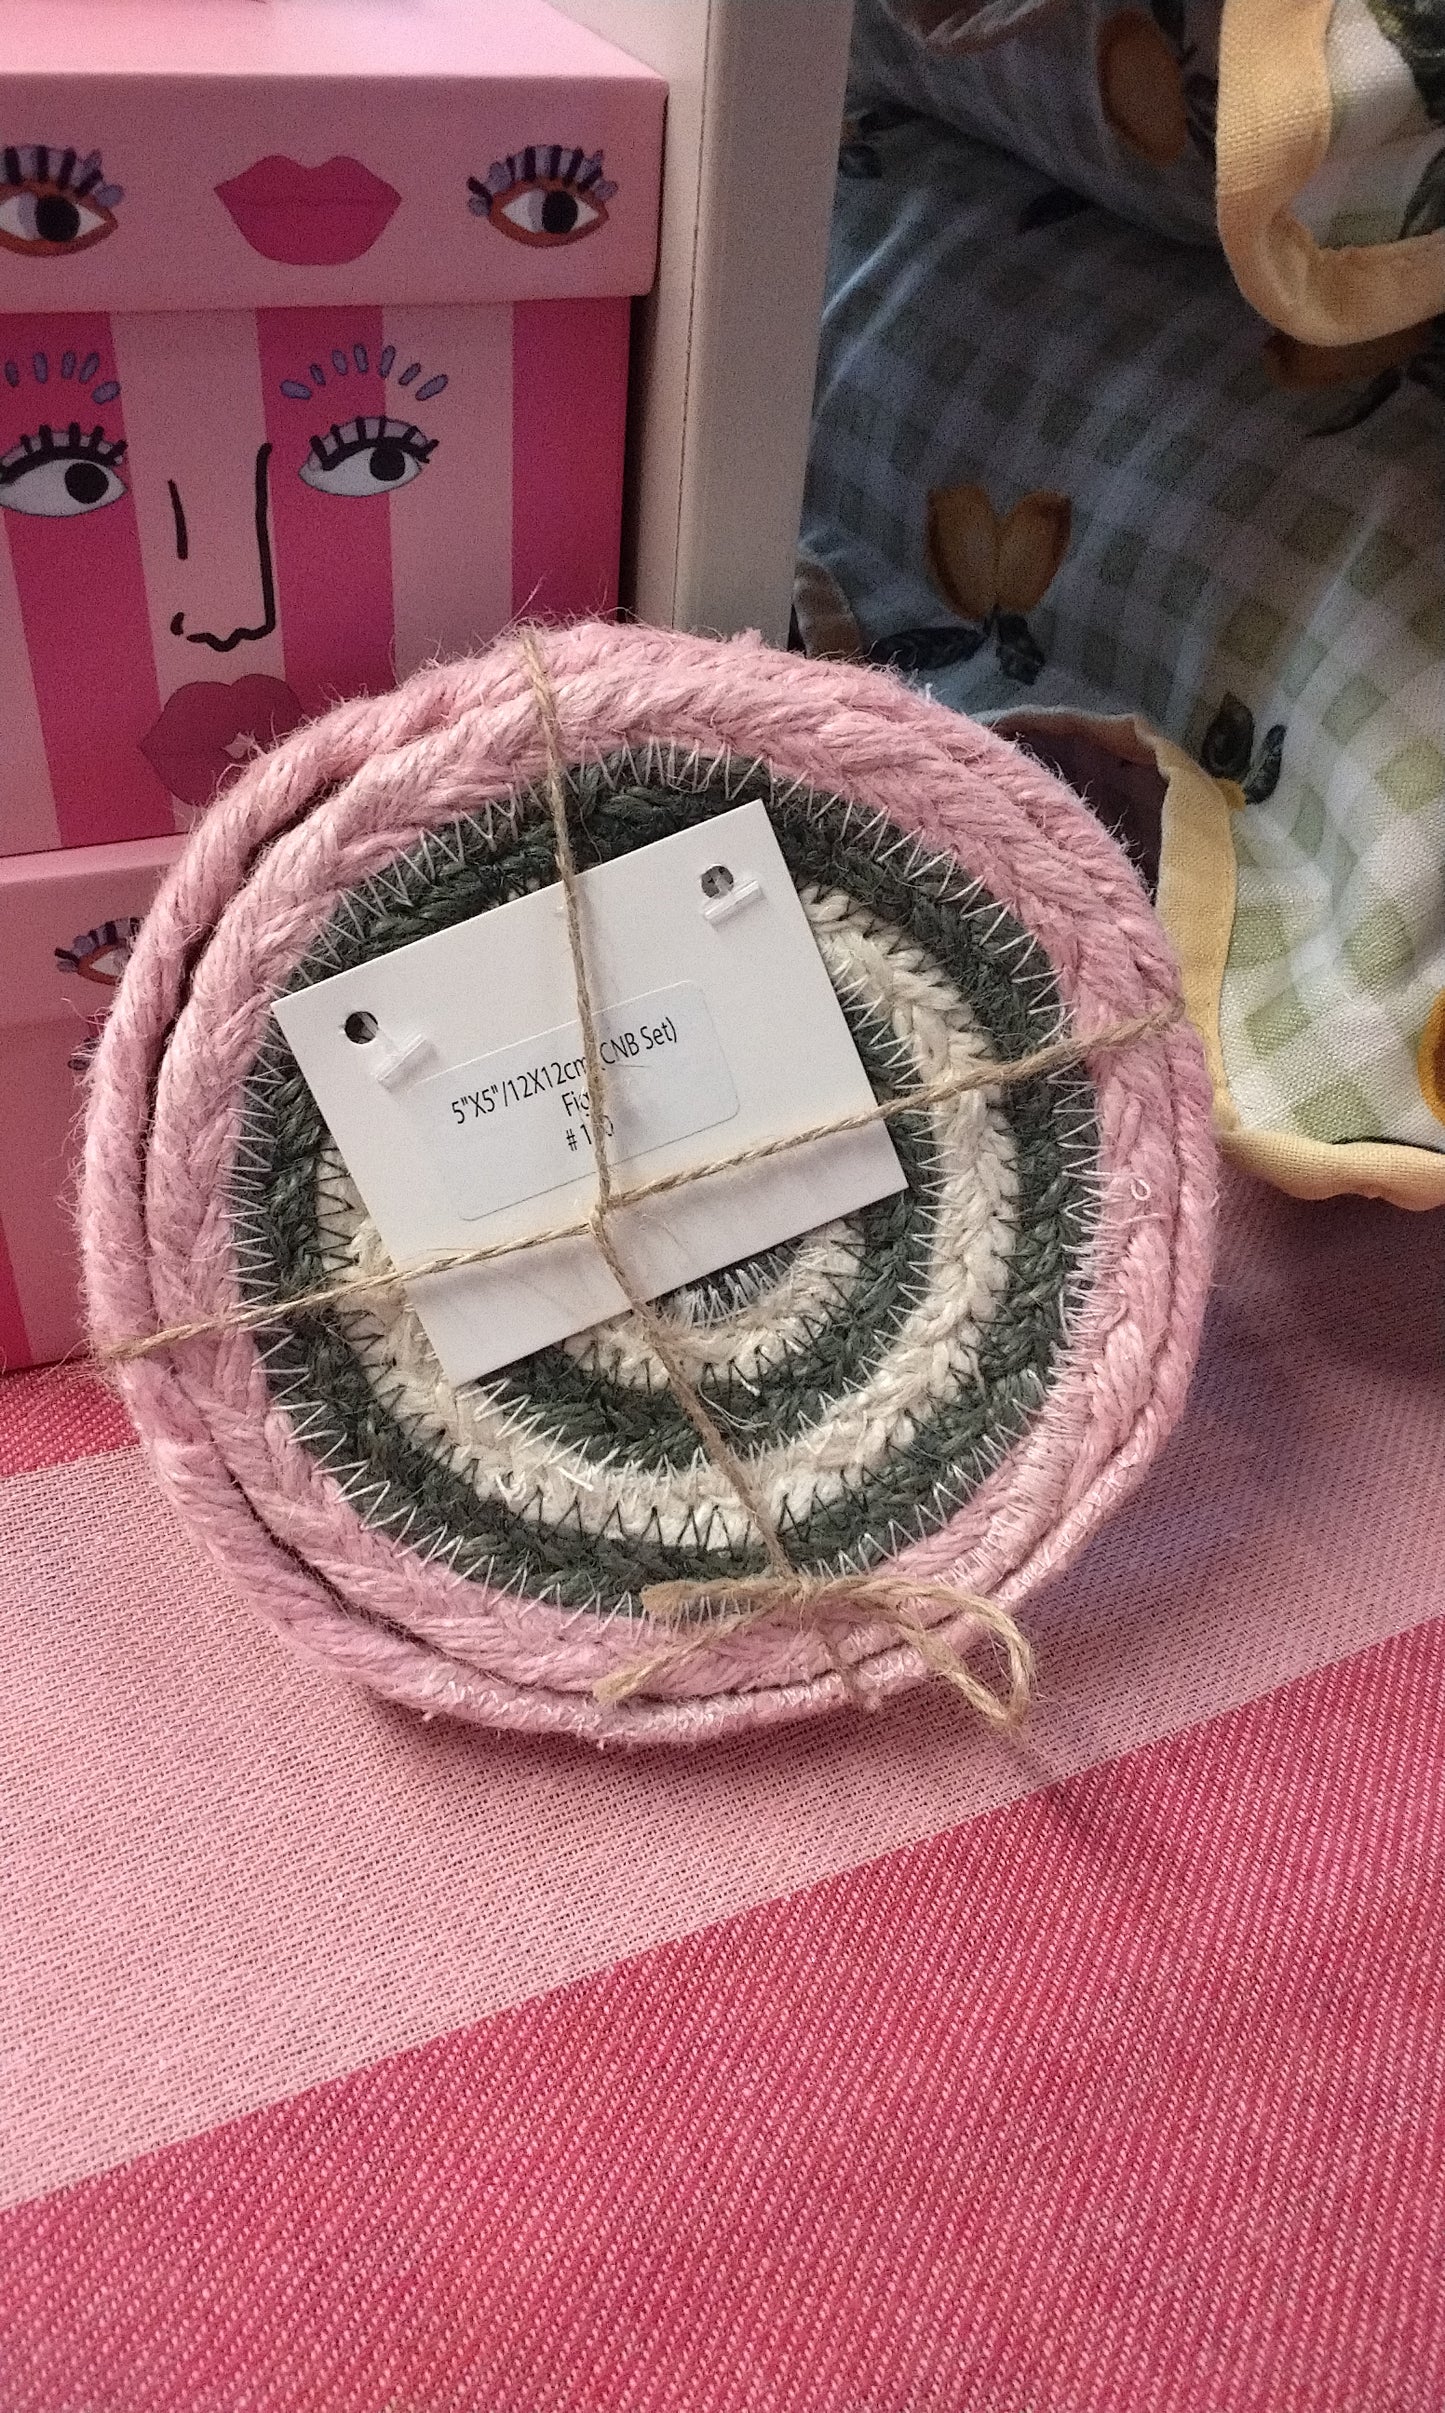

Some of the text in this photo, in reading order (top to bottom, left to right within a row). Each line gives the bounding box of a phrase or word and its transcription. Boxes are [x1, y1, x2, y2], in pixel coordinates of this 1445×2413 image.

[598, 1032, 640, 1070] CNB
[640, 1017, 677, 1050] Set)
[580, 1114, 615, 1145] 10
